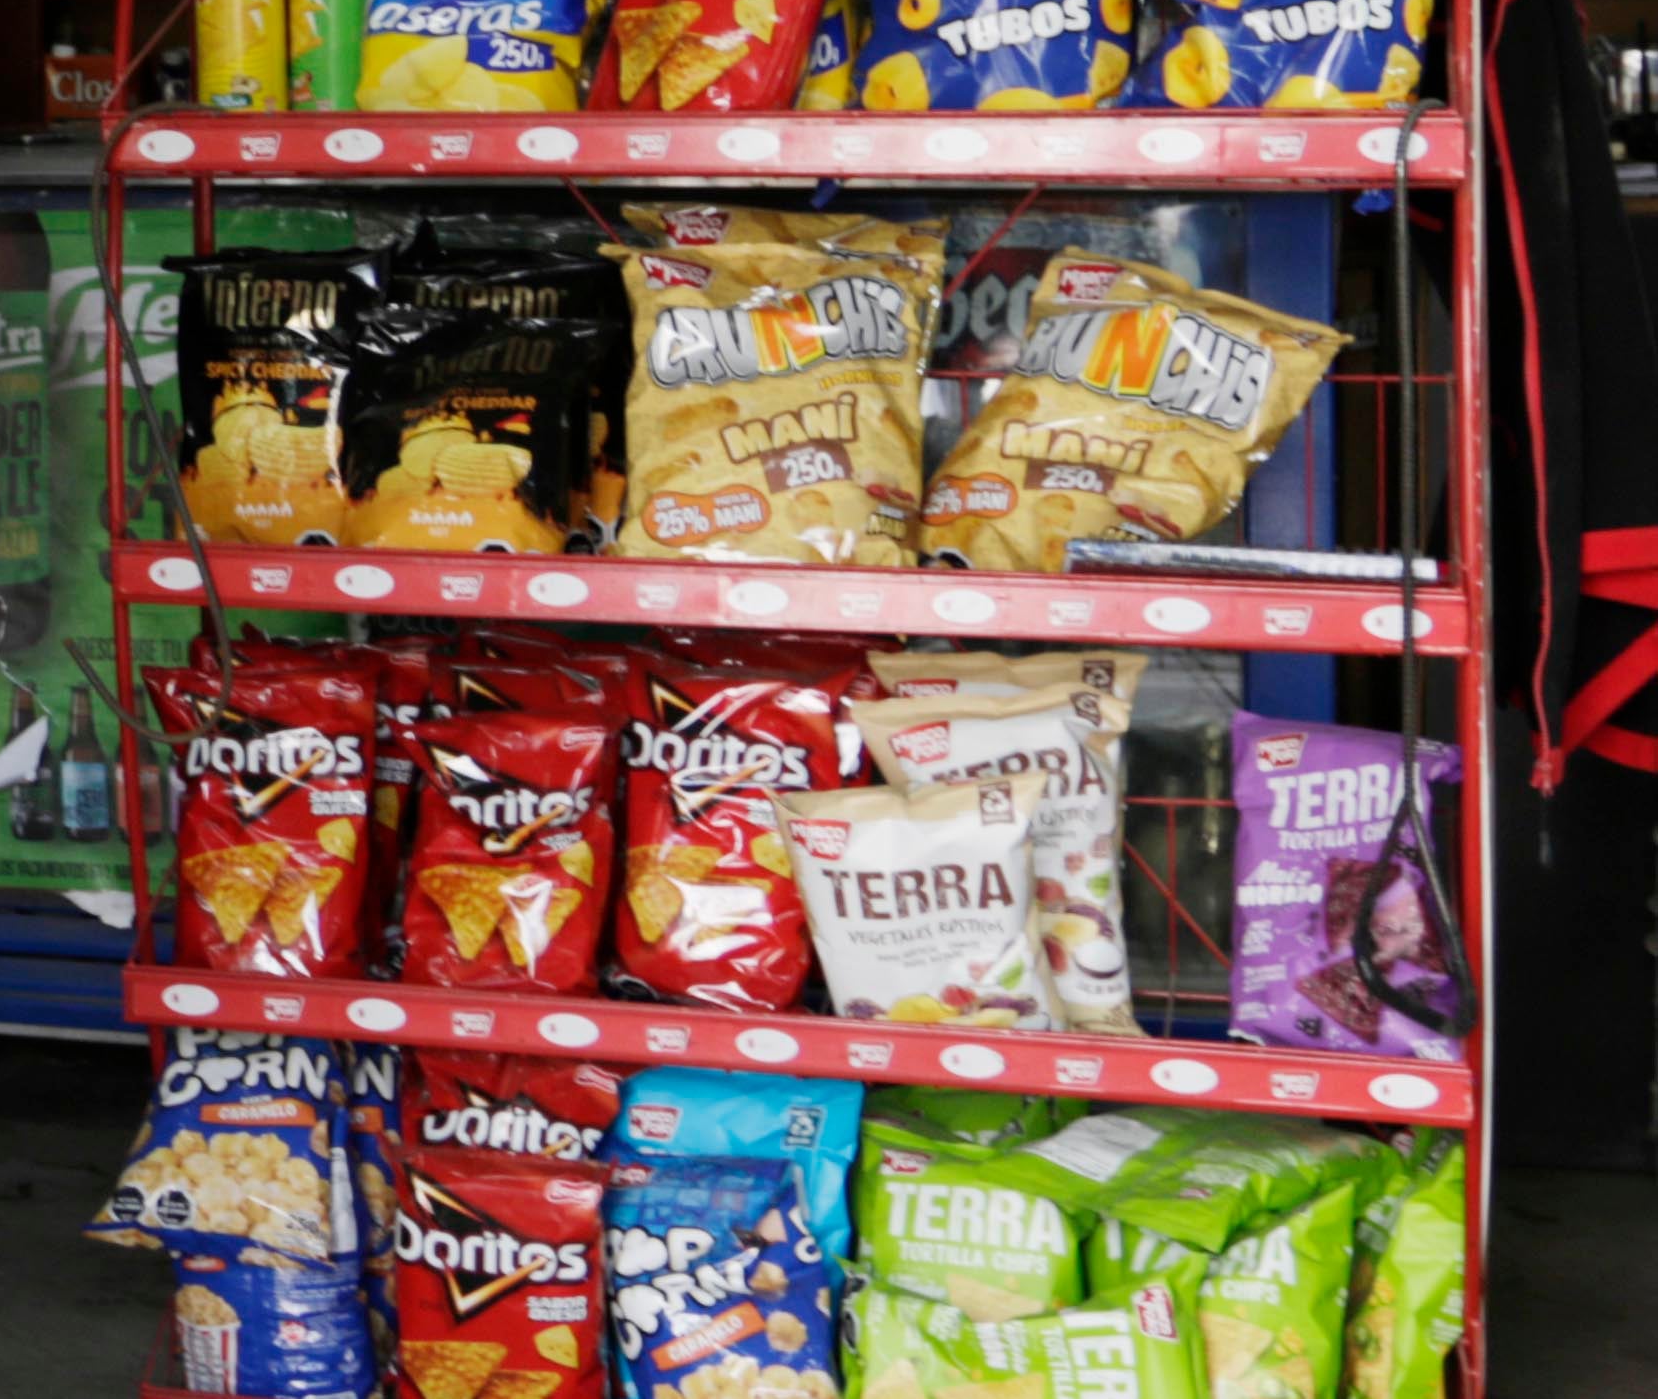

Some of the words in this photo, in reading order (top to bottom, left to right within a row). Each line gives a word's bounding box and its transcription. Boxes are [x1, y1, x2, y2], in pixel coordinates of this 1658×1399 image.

[203, 273, 339, 330] Inferno
[654, 505, 712, 539] 25%
[185, 730, 363, 778] Doritos
[624, 722, 812, 789] Doritos
[1265, 761, 1425, 831] TERRA
[821, 862, 1015, 922] TERRA
[217, 1104, 299, 1121] CARAMELO
[421, 1104, 604, 1160] Doritos
[392, 1211, 589, 1282] Doritos
[885, 1181, 1069, 1257] TERRA
[897, 1240, 986, 1270] TORTILLA
[990, 1249, 1052, 1278] CHIPS
[1220, 1278, 1282, 1306] CHIPS
